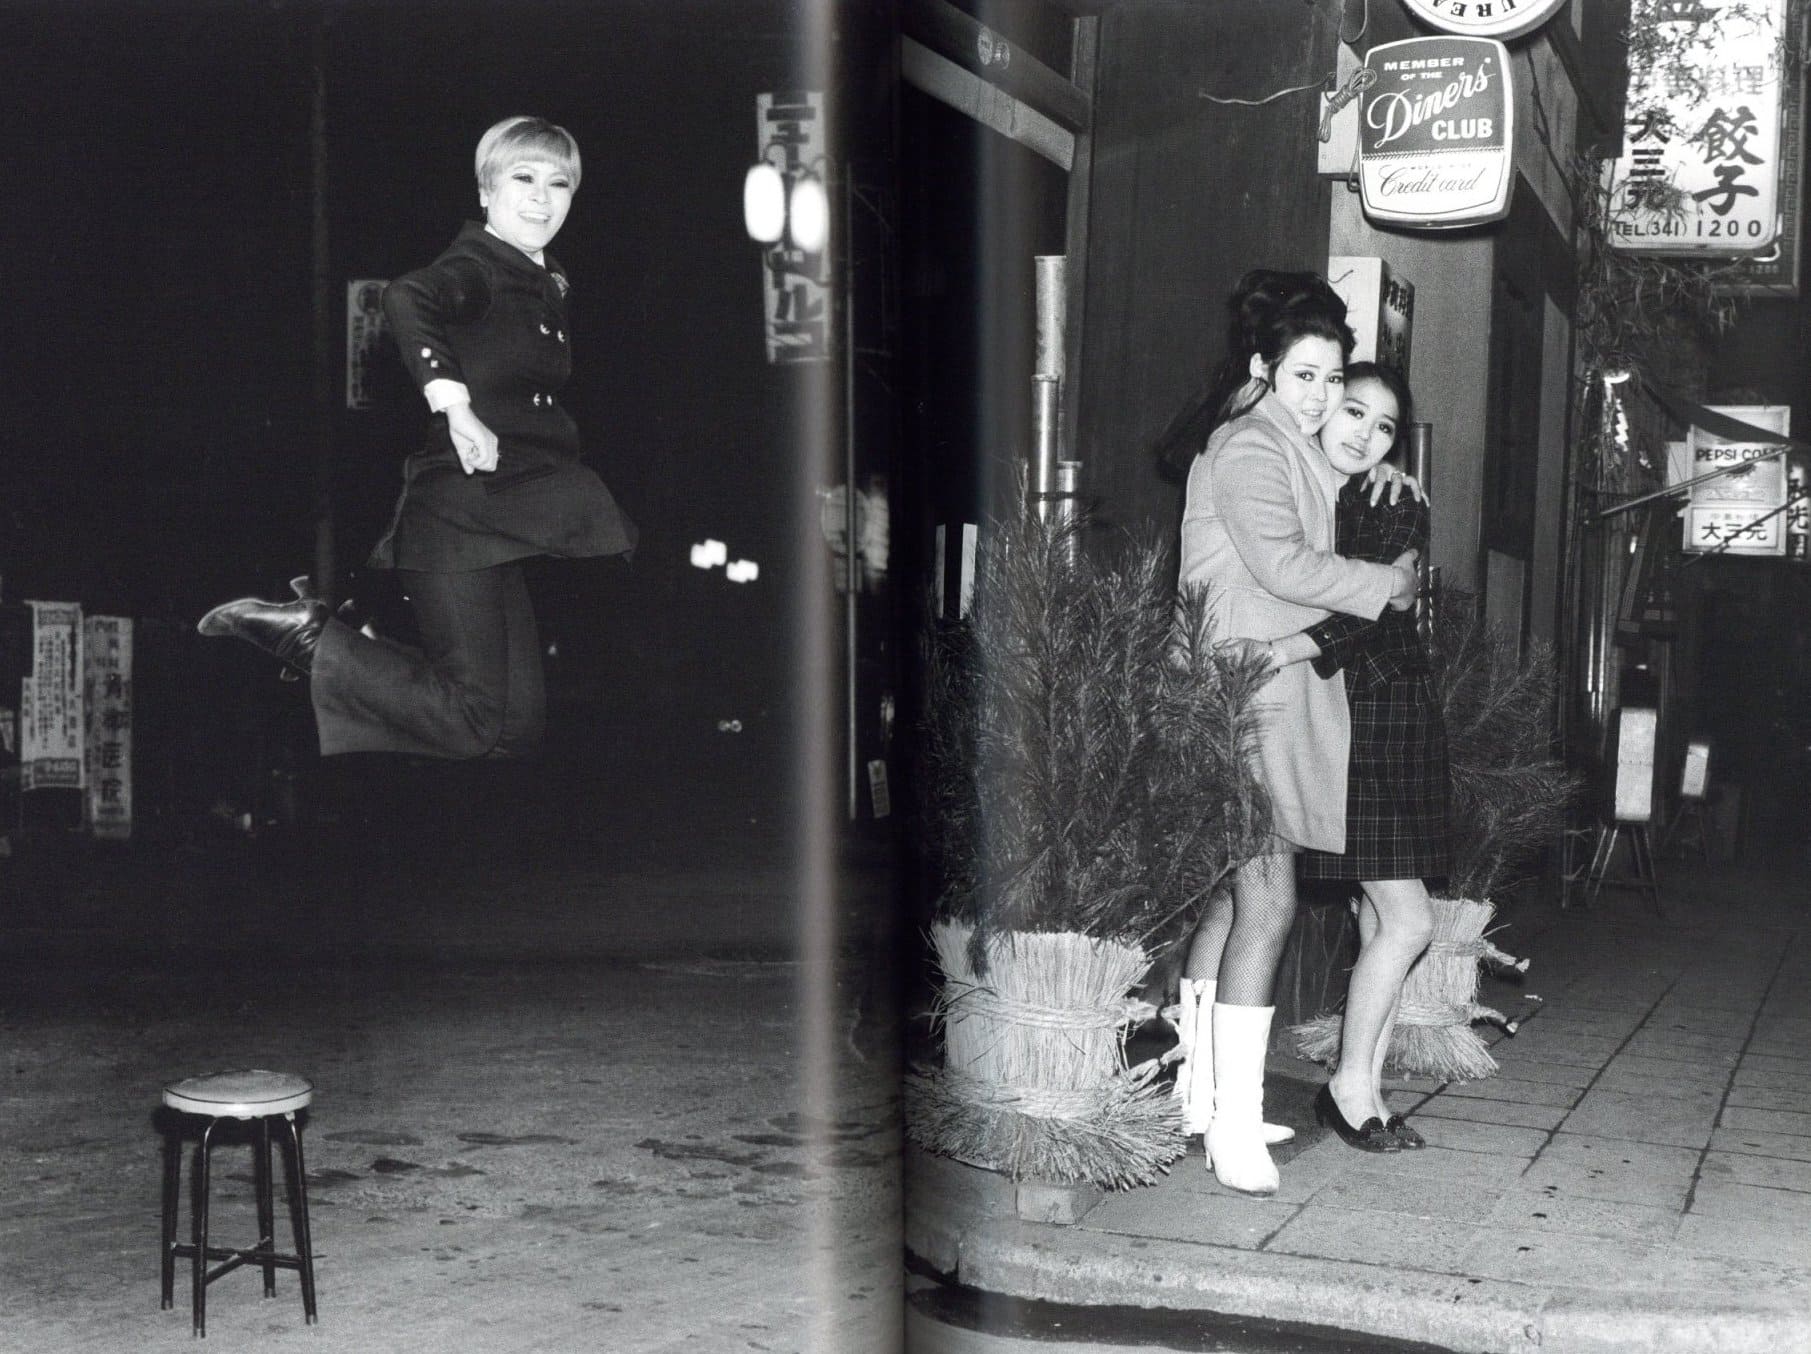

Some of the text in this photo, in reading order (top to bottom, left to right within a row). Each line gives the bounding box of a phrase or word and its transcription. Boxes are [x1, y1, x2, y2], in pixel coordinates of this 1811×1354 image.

[1384, 57, 1465, 71] MEMBER
[1400, 71, 1443, 81] OF THE
[1431, 118, 1493, 141] CLUB
[1692, 106, 1765, 216] 餃子
[1378, 164, 1440, 197] Credit
[1695, 448, 1737, 462] PEPSI
